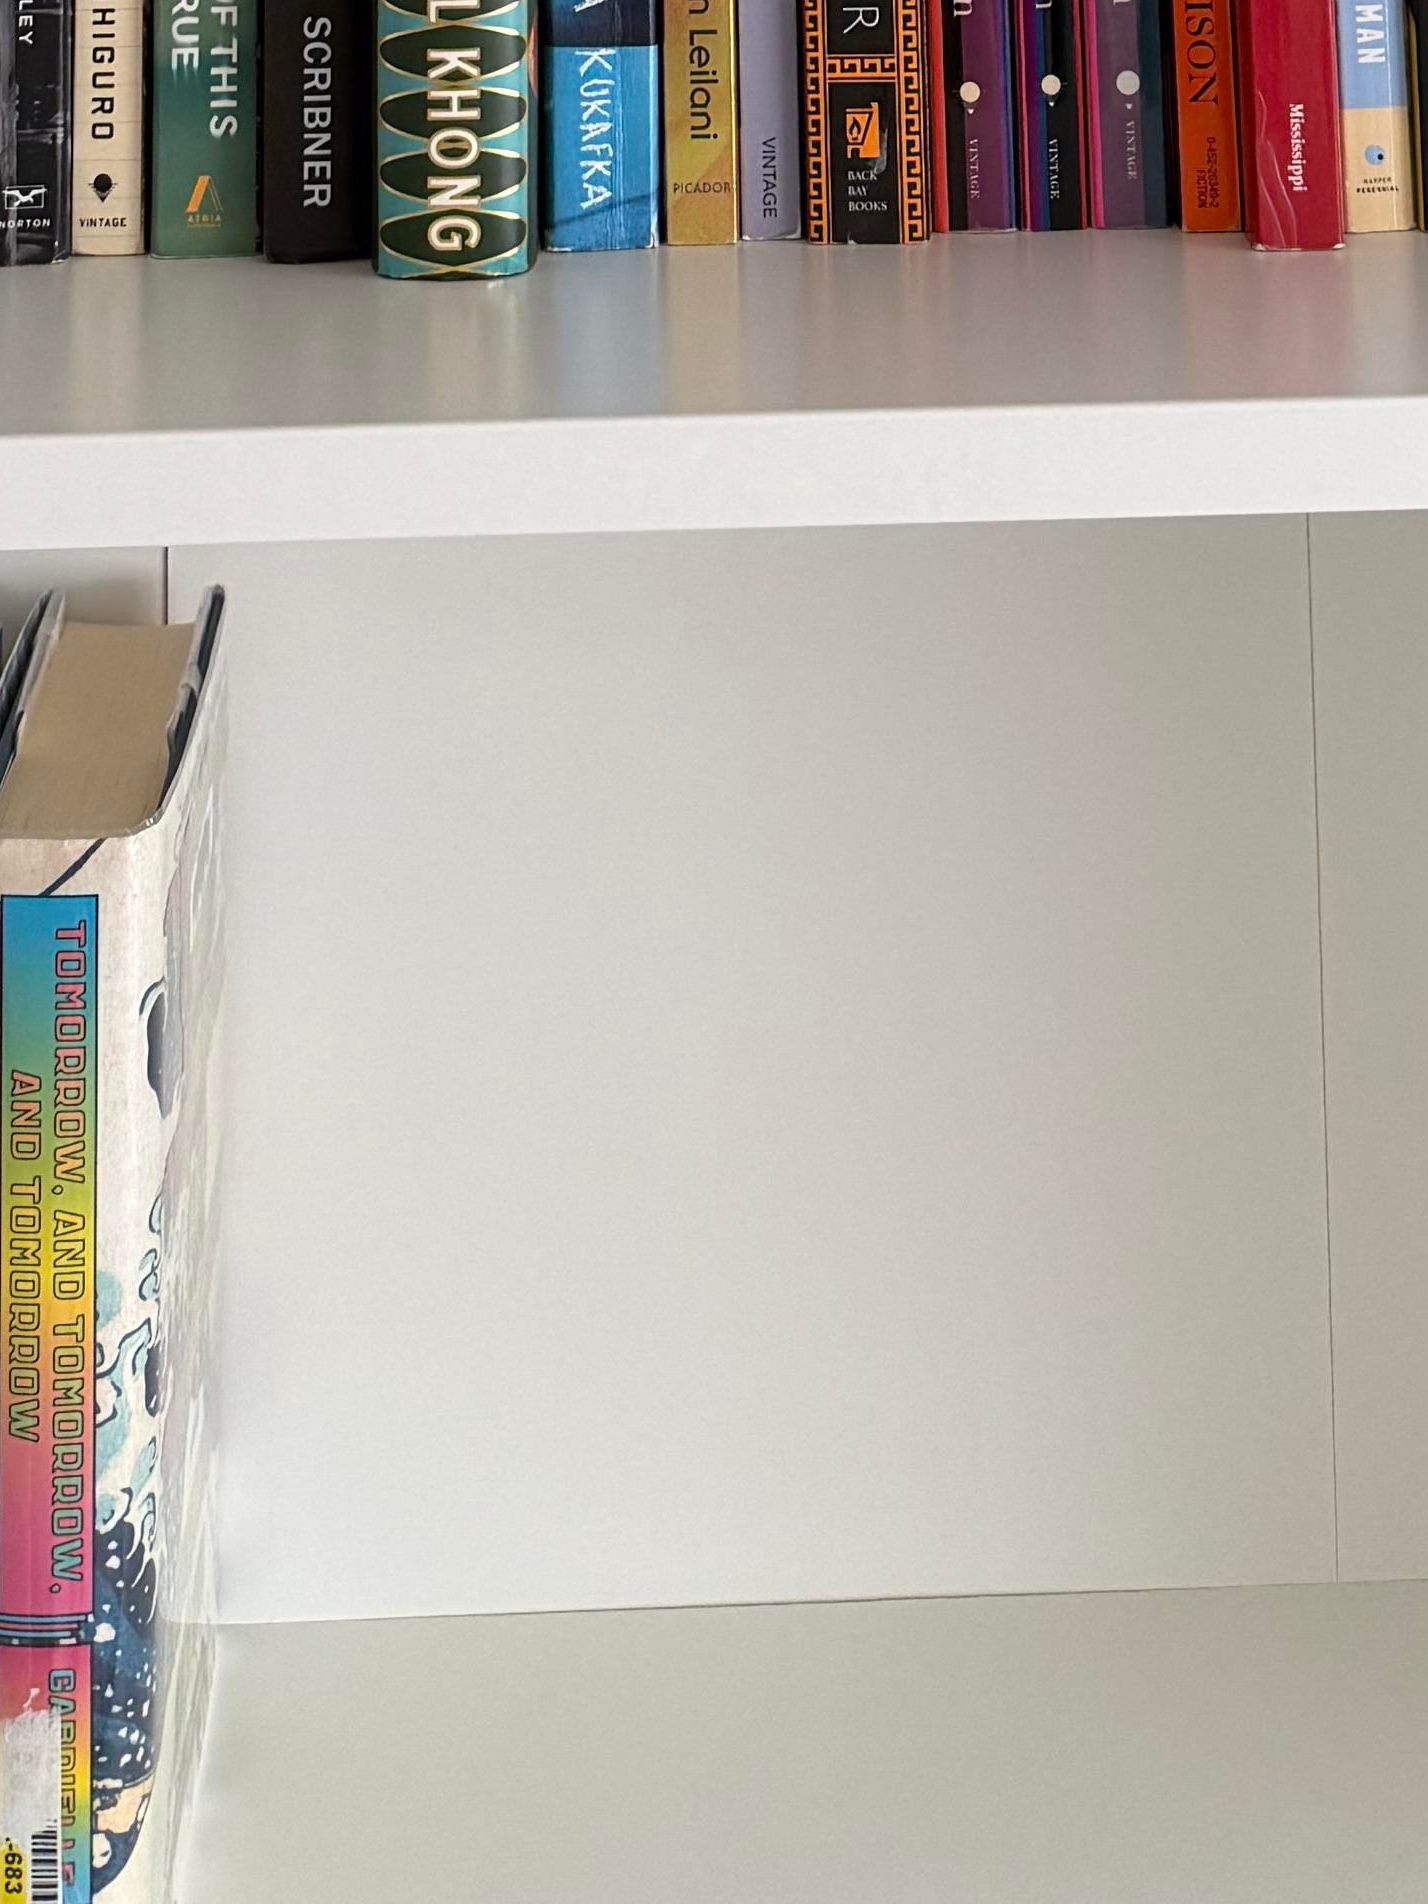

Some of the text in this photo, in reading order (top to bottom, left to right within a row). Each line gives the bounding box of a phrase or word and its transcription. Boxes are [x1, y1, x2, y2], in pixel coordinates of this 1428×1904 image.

[426, 48, 478, 250] KHONG
[1287, 104, 1307, 196] Mississippi
[848, 168, 877, 182] BACK
[674, 181, 731, 196] PICADOR
[848, 186, 866, 196] BAY
[849, 199, 887, 211] BOOKS
[80, 218, 126, 227] VINTAGE
